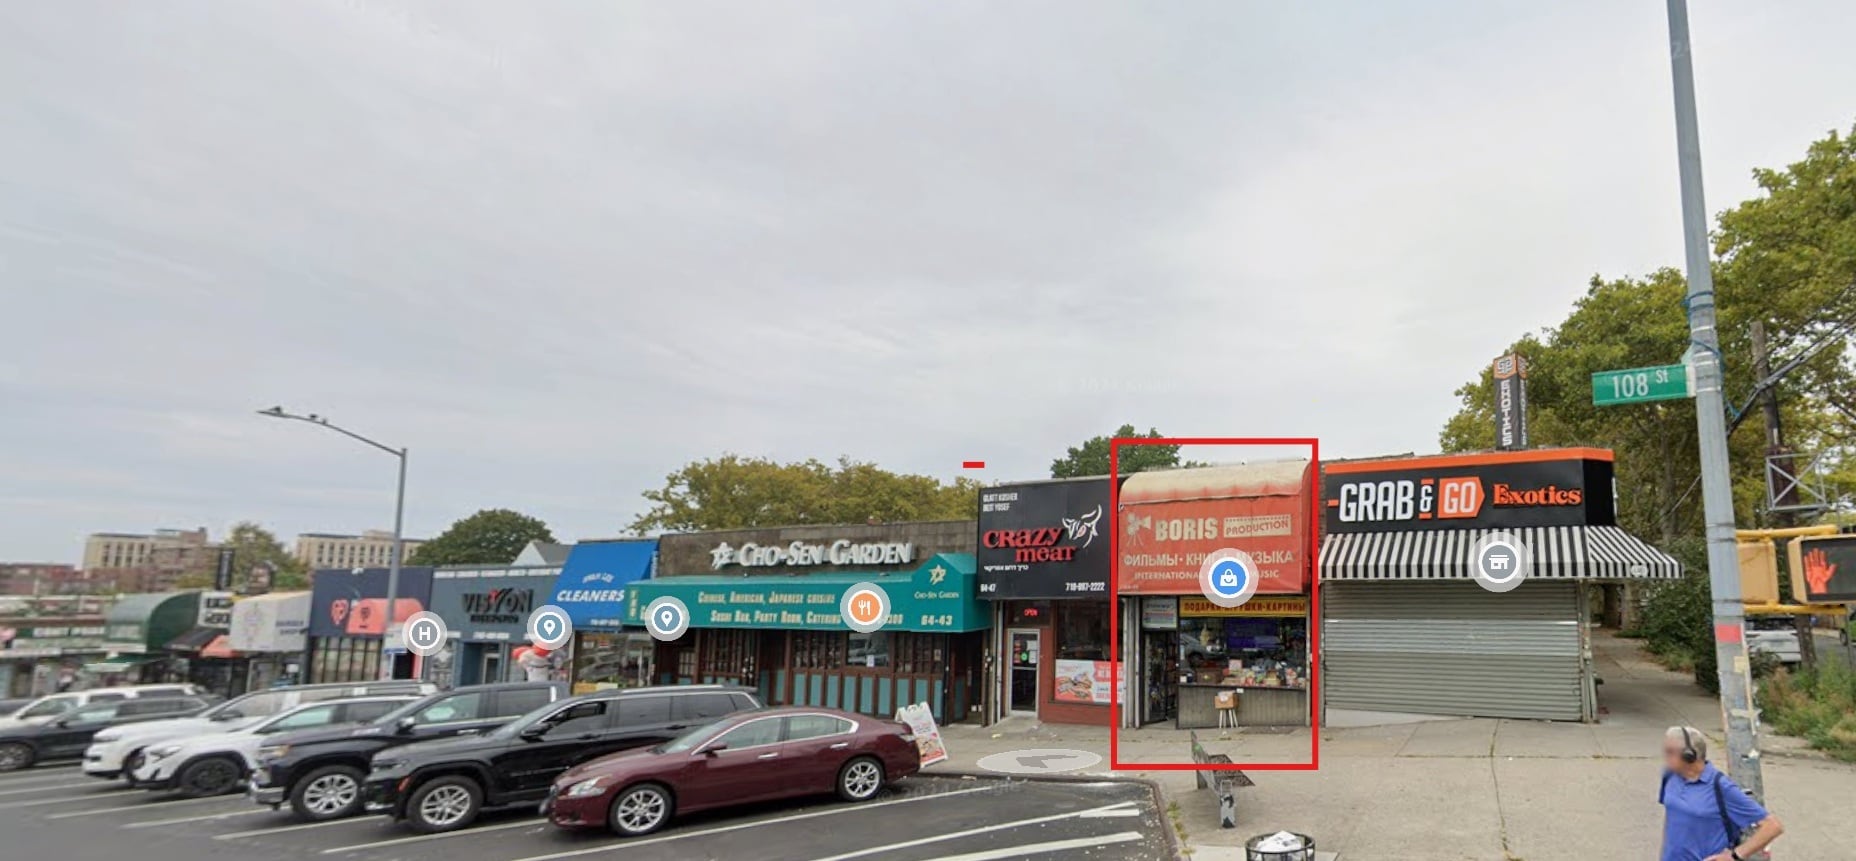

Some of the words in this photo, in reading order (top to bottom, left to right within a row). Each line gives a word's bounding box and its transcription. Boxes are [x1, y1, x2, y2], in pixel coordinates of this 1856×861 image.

[1612, 373, 1649, 399] 108
[1656, 369, 1669, 384] St
[1339, 479, 1414, 522] GRAB
[1419, 484, 1433, 514] &
[1443, 481, 1477, 514] GO
[1493, 483, 1582, 507] Exotics
[1155, 517, 1218, 542] BORIS
[1225, 519, 1289, 535] PRODUCTION
[829, 539, 913, 565] GARDEN
[1123, 553, 1178, 566] ФИЛЬМЫ
[556, 589, 625, 602] CLEANERS
[921, 614, 953, 626] 64-43
[1024, 608, 1038, 617] OPEN
